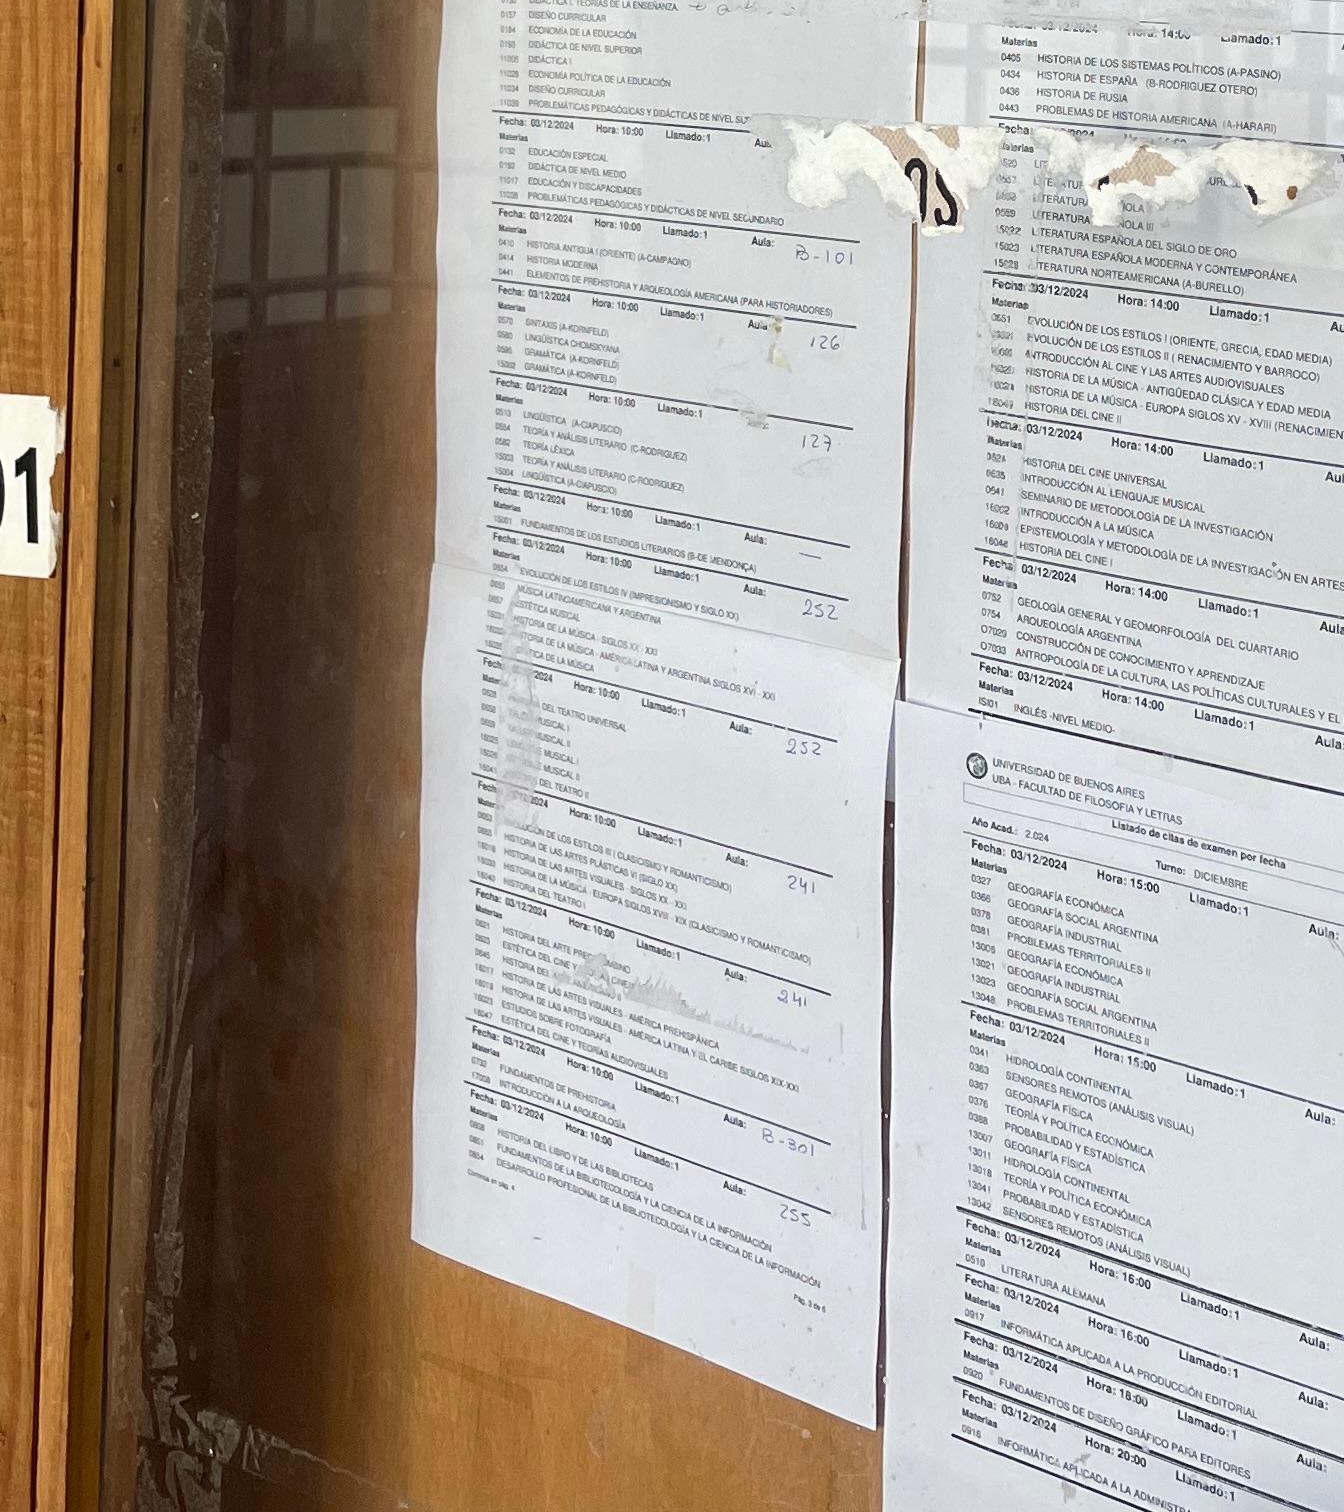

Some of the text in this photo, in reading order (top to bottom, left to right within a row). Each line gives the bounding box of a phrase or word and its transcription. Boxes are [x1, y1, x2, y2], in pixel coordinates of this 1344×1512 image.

[751, 235, 776, 248] Aula:
[743, 583, 767, 597] Aula:
[802, 598, 840, 621] 252
[729, 720, 753, 736] Aula:
[786, 737, 823, 756] 252
[971, 838, 1161, 894] Fecha: 03/12/2024 Hora: 15:00
[1155, 859, 1249, 892] Turno: DICIEMBRE
[971, 873, 1125, 918] 0327 GEOGRAFÍA ECONÓMICA
[1305, 1107, 1336, 1126] Aula:
[723, 1179, 747, 1197] Aula:
[966, 1218, 1331, 1352] Fecha: 03/12/2024 Hora: 16:00 Aula:
[1001, 1263, 1106, 1307] LITERATURA ALEMANA
